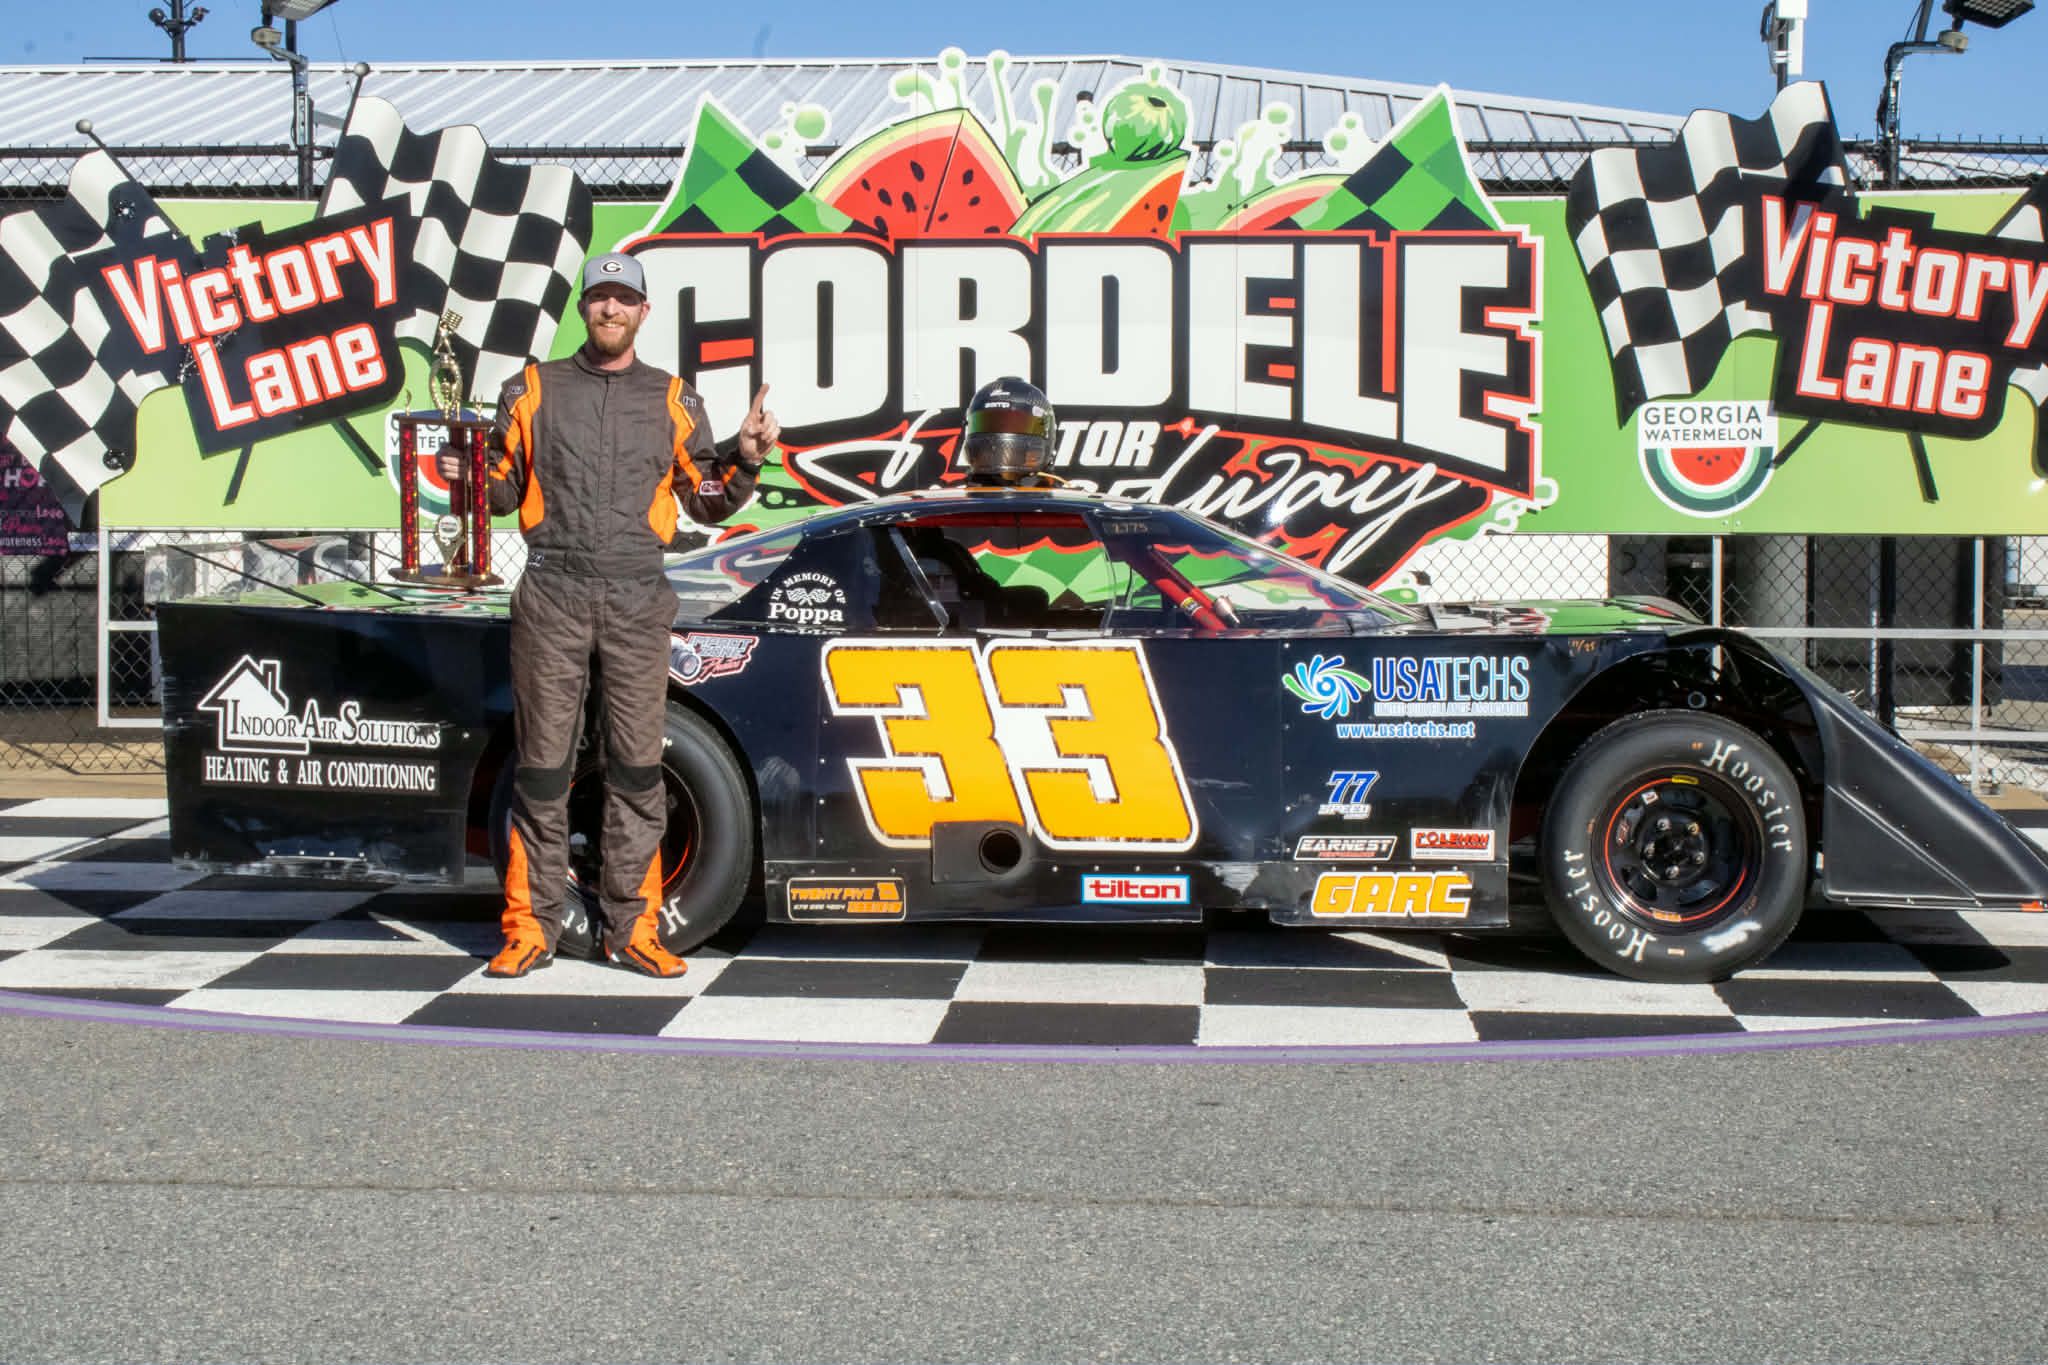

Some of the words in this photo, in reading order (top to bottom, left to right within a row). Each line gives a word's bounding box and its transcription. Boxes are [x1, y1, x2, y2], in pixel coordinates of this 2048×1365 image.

[102, 216, 396, 354] Victory
[1762, 195, 2048, 348] Victory
[191, 323, 387, 431] Lane
[632, 244, 1507, 471] CORDELE
[1797, 300, 1991, 420] Lane
[1644, 405, 1761, 425] GEORGIA
[1645, 426, 1762, 442] WATERMELON
[957, 421, 1161, 467] TOR
[784, 572, 836, 588] MEMORY
[768, 602, 844, 624] Poppa
[230, 699, 297, 738] INDOOR
[302, 699, 339, 740] AIR
[341, 701, 438, 746] SOLUTIONS
[822, 639, 1199, 852] 33
[1336, 721, 1476, 738] www.usatechs.net
[205, 756, 270, 783] HEATING
[277, 761, 288, 784] &
[297, 761, 323, 785] AIR
[328, 762, 436, 791] CONDITIONING
[1326, 771, 1380, 804] 77
[1700, 739, 1793, 853] Hoosier
[1300, 839, 1393, 852] EARNEST
[1089, 880, 1181, 901] tilton
[1311, 872, 1473, 918] GARC
[1564, 849, 1658, 962] Hoosier
